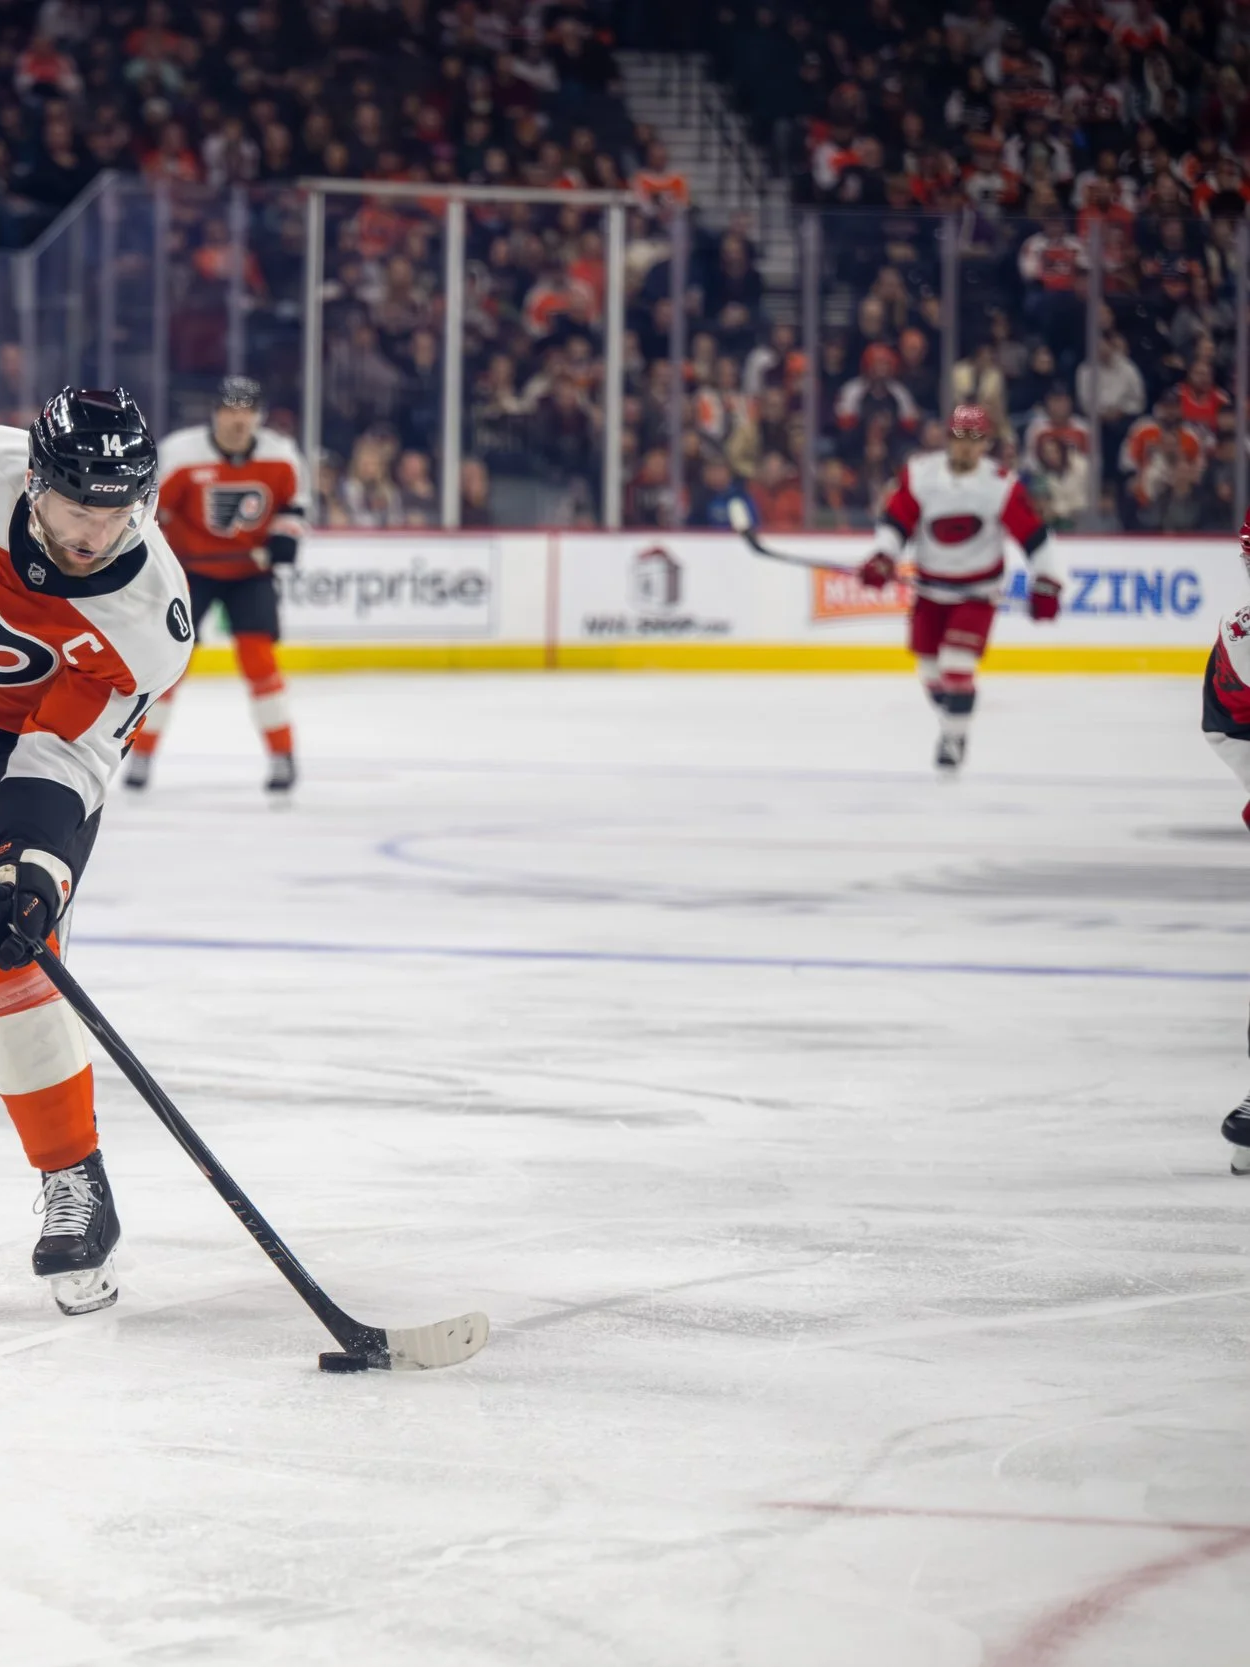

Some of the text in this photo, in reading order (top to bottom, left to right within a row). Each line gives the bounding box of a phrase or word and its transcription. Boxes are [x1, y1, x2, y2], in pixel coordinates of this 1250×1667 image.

[101, 434, 124, 457] 14
[90, 484, 129, 493] CCM
[275, 556, 488, 619] terprise
[173, 602, 189, 638] 1
[62, 632, 104, 665] C
[228, 1199, 286, 1264] FLYLITE
